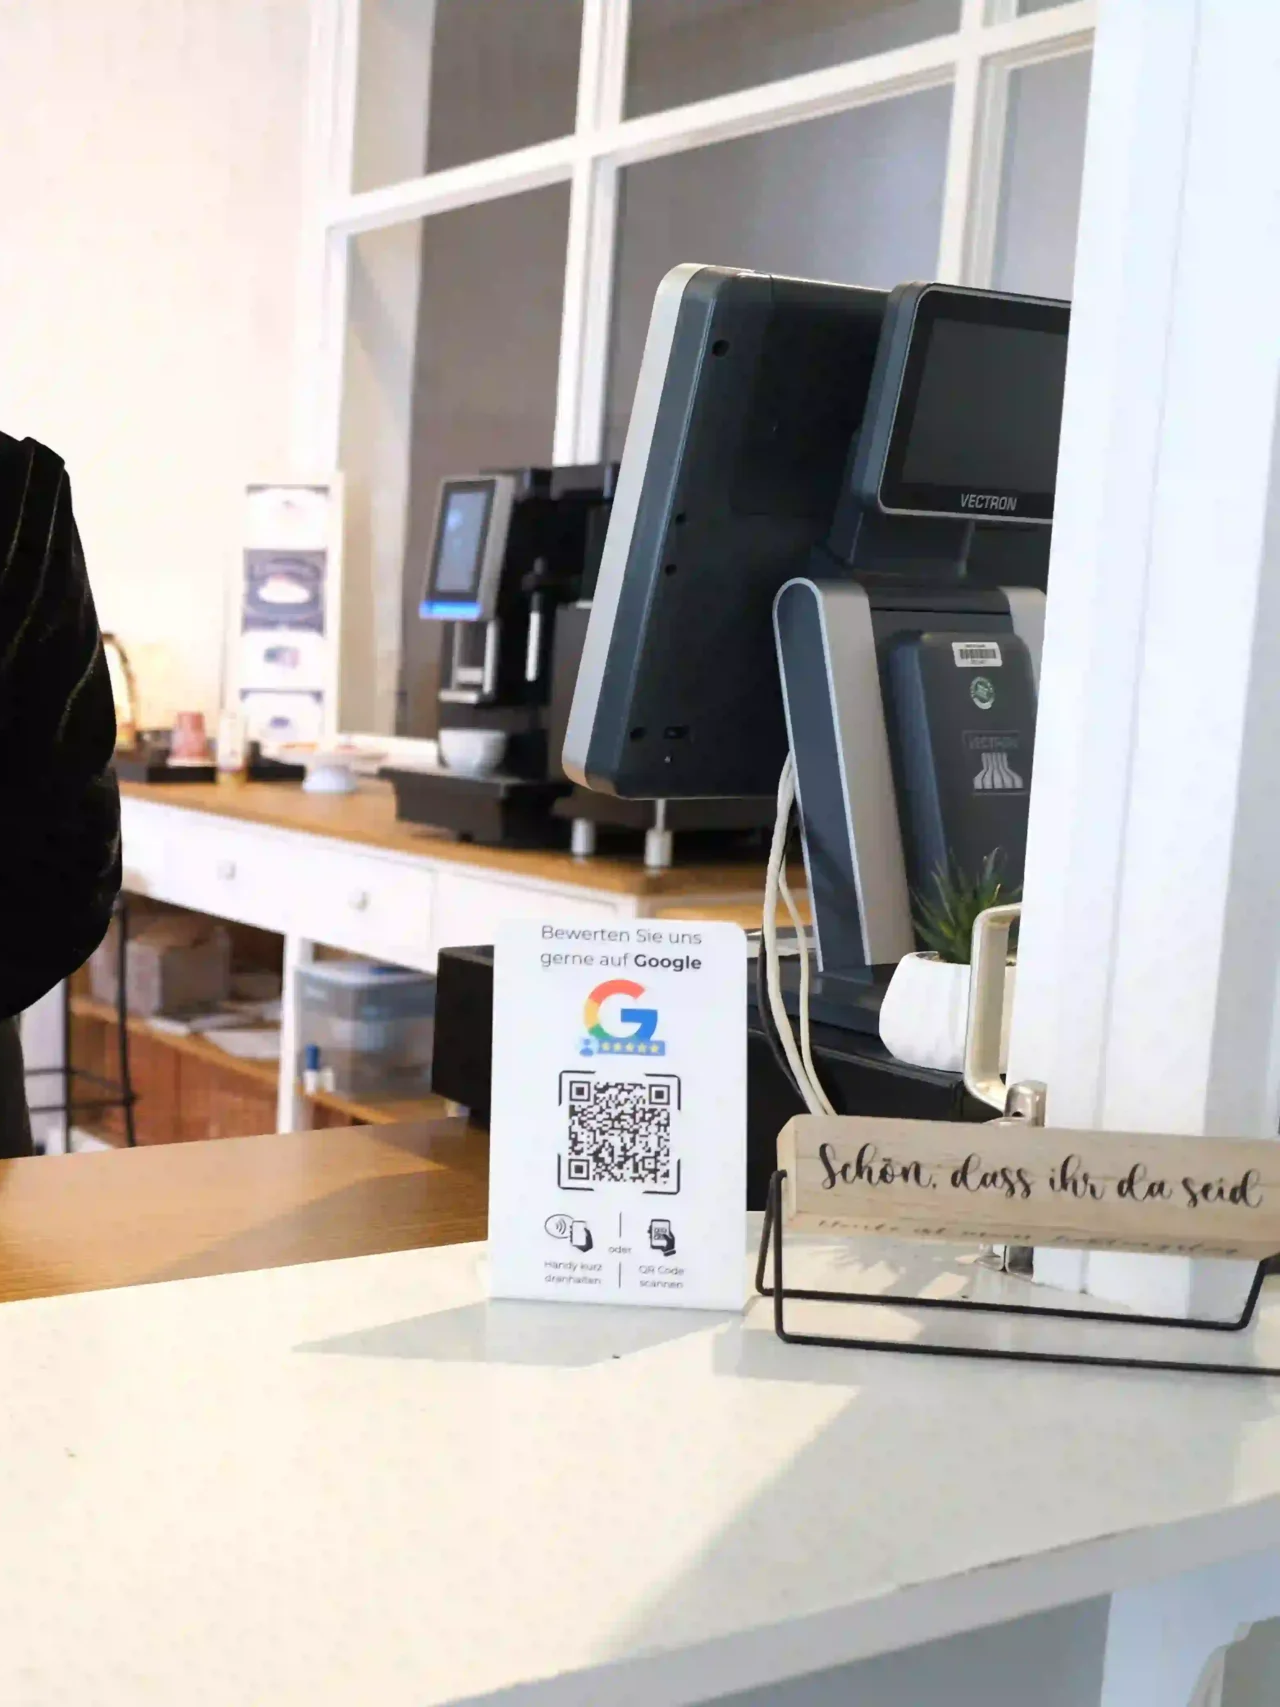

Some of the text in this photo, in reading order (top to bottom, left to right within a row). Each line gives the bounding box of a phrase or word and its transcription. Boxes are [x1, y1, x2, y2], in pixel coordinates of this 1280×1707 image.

[960, 493, 1018, 511] VECTRON
[541, 925, 702, 945] Bewerten Sie uns
[540, 952, 702, 972] gerne auf Google
[950, 1152, 1033, 1199] dass
[1048, 1153, 1106, 1200] ihr
[1117, 1162, 1172, 1201] da
[1181, 1168, 1264, 1209] seid
[608, 1245, 632, 1254] oder
[544, 1260, 602, 1272] Handy kurz
[638, 1265, 685, 1276] QR Code
[544, 1274, 602, 1285] dranhalten
[639, 1279, 684, 1289] scannen
